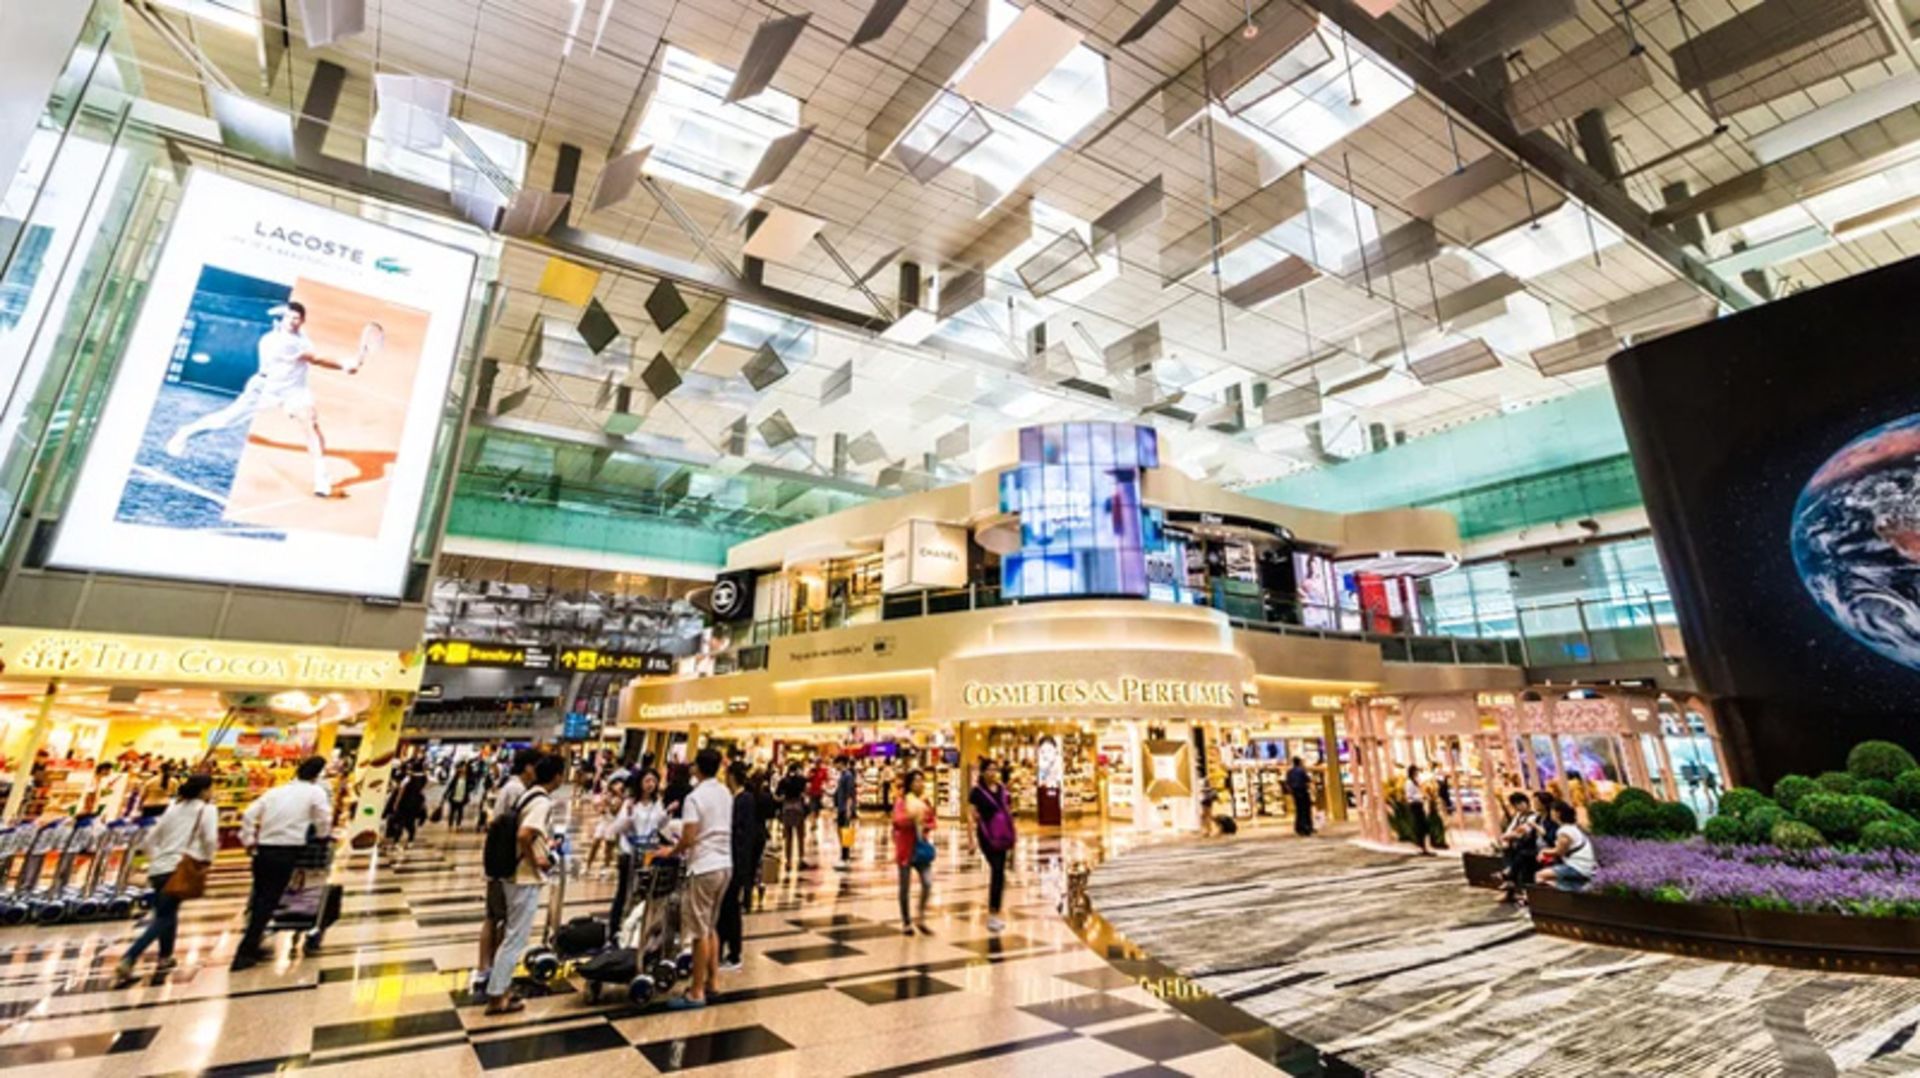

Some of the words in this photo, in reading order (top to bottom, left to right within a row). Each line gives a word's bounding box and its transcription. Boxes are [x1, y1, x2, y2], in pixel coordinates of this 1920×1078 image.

[254, 221, 364, 264] LACOSTE
[91, 642, 161, 671] THE
[178, 646, 286, 678] COCOA
[298, 652, 384, 682] TREES
[964, 681, 1087, 706] COSMETICS
[1094, 681, 1115, 701] &
[1122, 678, 1235, 704] PERFUMES
